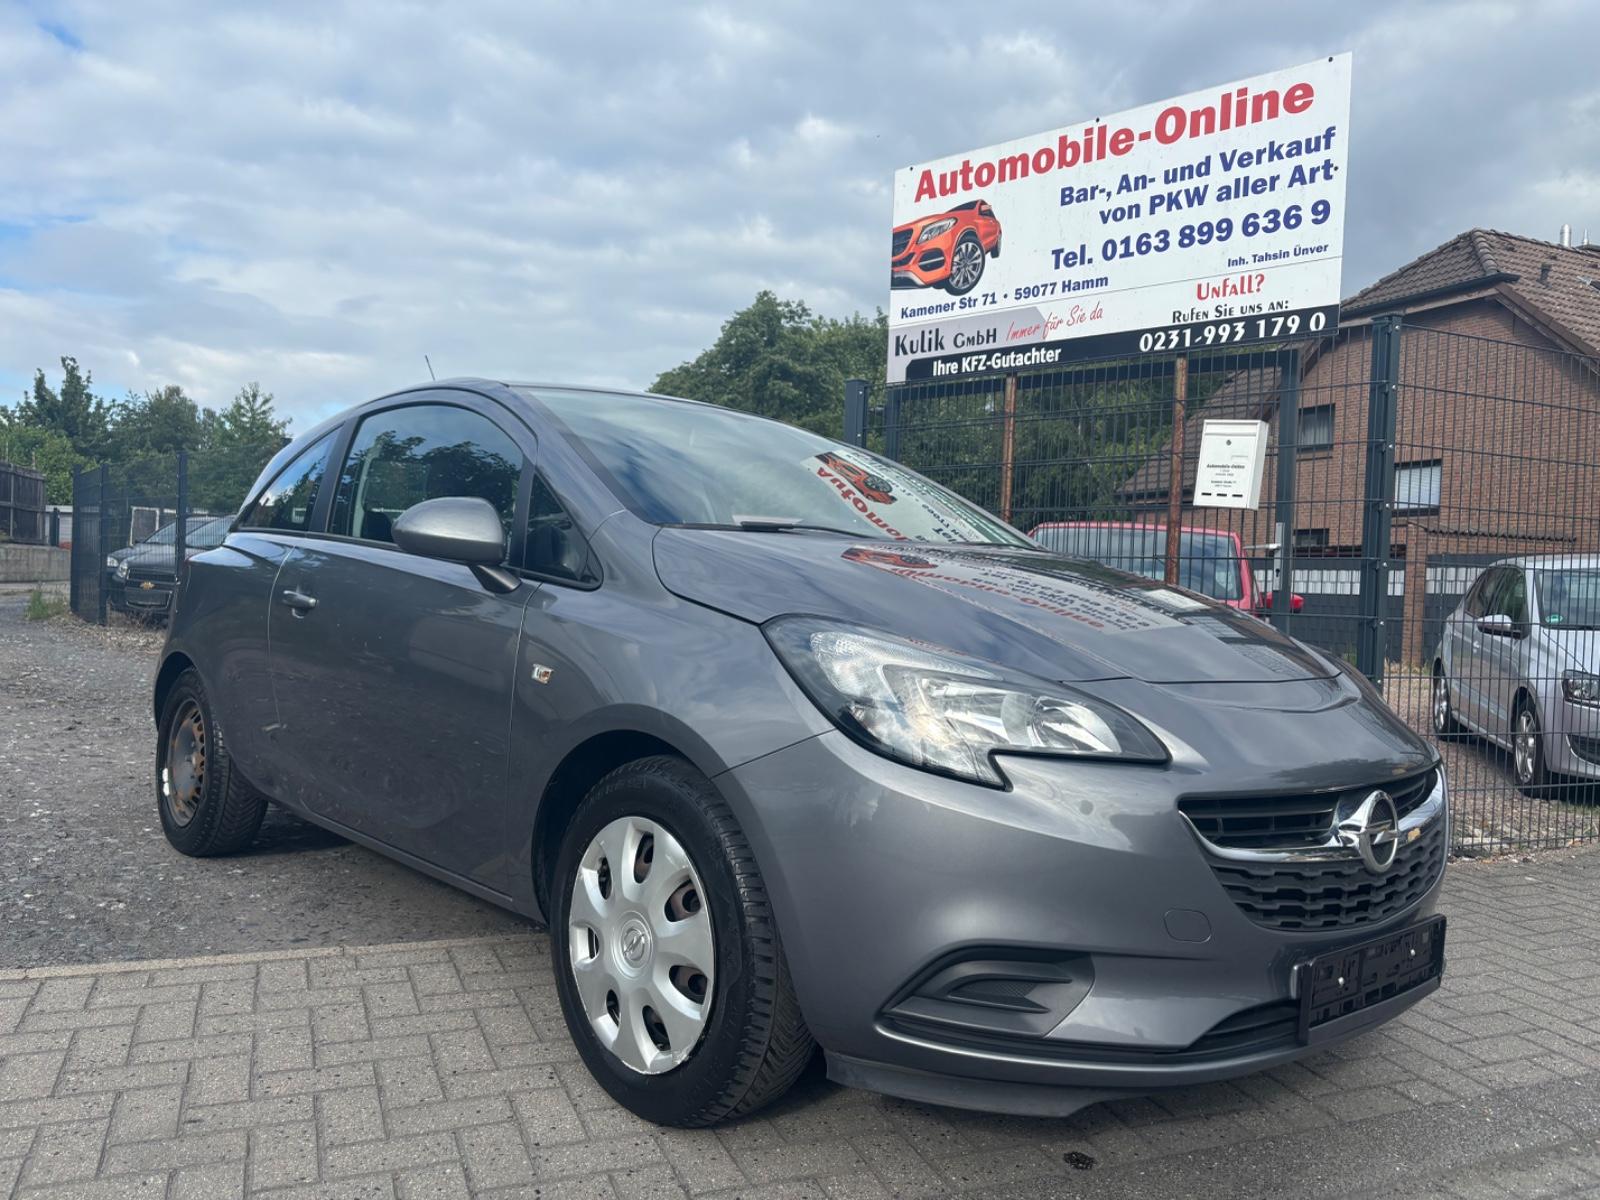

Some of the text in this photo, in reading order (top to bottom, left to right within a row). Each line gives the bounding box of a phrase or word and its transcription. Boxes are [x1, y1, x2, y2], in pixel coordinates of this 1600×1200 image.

[914, 82, 1315, 203] Automobile-Online
[1060, 126, 1337, 207] Bar-, An- und Verkauf
[1099, 158, 1335, 225] von PKW aller Art
[1051, 199, 1332, 271] Tel. 0163 899 636 9
[1227, 243, 1329, 268] Inh. Tahsin Ünver
[900, 276, 1109, 320] Kamener Str 71 59077 Hamm
[894, 327, 945, 357] Kulik
[1005, 301, 1104, 342] Immer für Sie da
[1139, 311, 1327, 352] 0231-993 179 0
[932, 347, 1062, 377] Ihre KFZ-Gutachter
